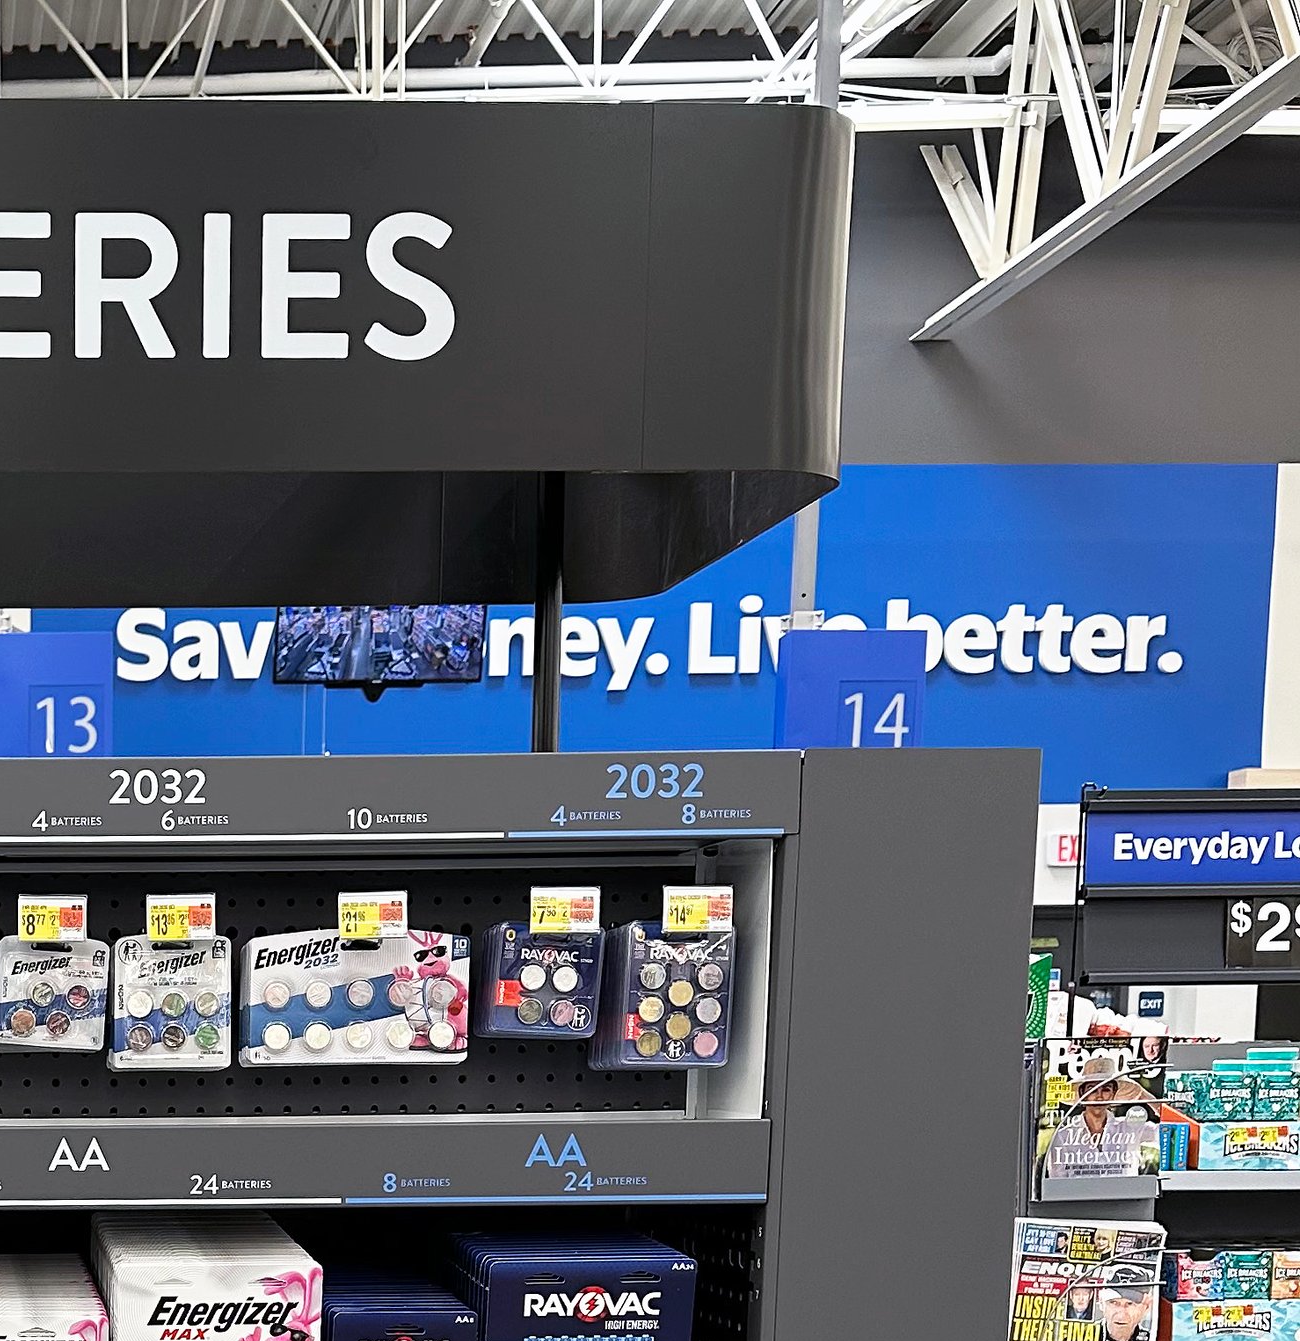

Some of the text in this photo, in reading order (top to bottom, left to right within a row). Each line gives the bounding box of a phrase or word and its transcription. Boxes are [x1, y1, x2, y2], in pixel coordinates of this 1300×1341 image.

[116, 606, 276, 682] Sav
[33, 695, 98, 756] 13
[844, 692, 910, 748] 14
[108, 768, 206, 805] 2032
[605, 762, 705, 799] 2032
[31, 810, 103, 832] 4 BATTERIES
[347, 807, 428, 830] 10 BATTERIES
[681, 803, 752, 825] 8 BATTERIES
[1113, 830, 1270, 865] Everyday
[254, 935, 340, 971] Energizer
[453, 939, 467, 950] 10
[521, 948, 579, 963] RAYOVAC
[304, 953, 340, 971] 2032
[1140, 999, 1163, 1009] EXIT
[524, 1132, 588, 1168] AA
[1064, 1128, 1136, 1150] Meghan
[48, 1137, 110, 1172] AA
[189, 1173, 272, 1195] 24 BATTERIES
[382, 1172, 451, 1193] 8 BATTERIES
[563, 1171, 648, 1192] 24 BATTERIES
[147, 1296, 298, 1331] Energizer
[524, 1286, 661, 1323] RAYOVAC
[1015, 1295, 1066, 1320] INSIDE
[160, 1328, 208, 1340] MAX
[1013, 1319, 1054, 1341] THEIR
